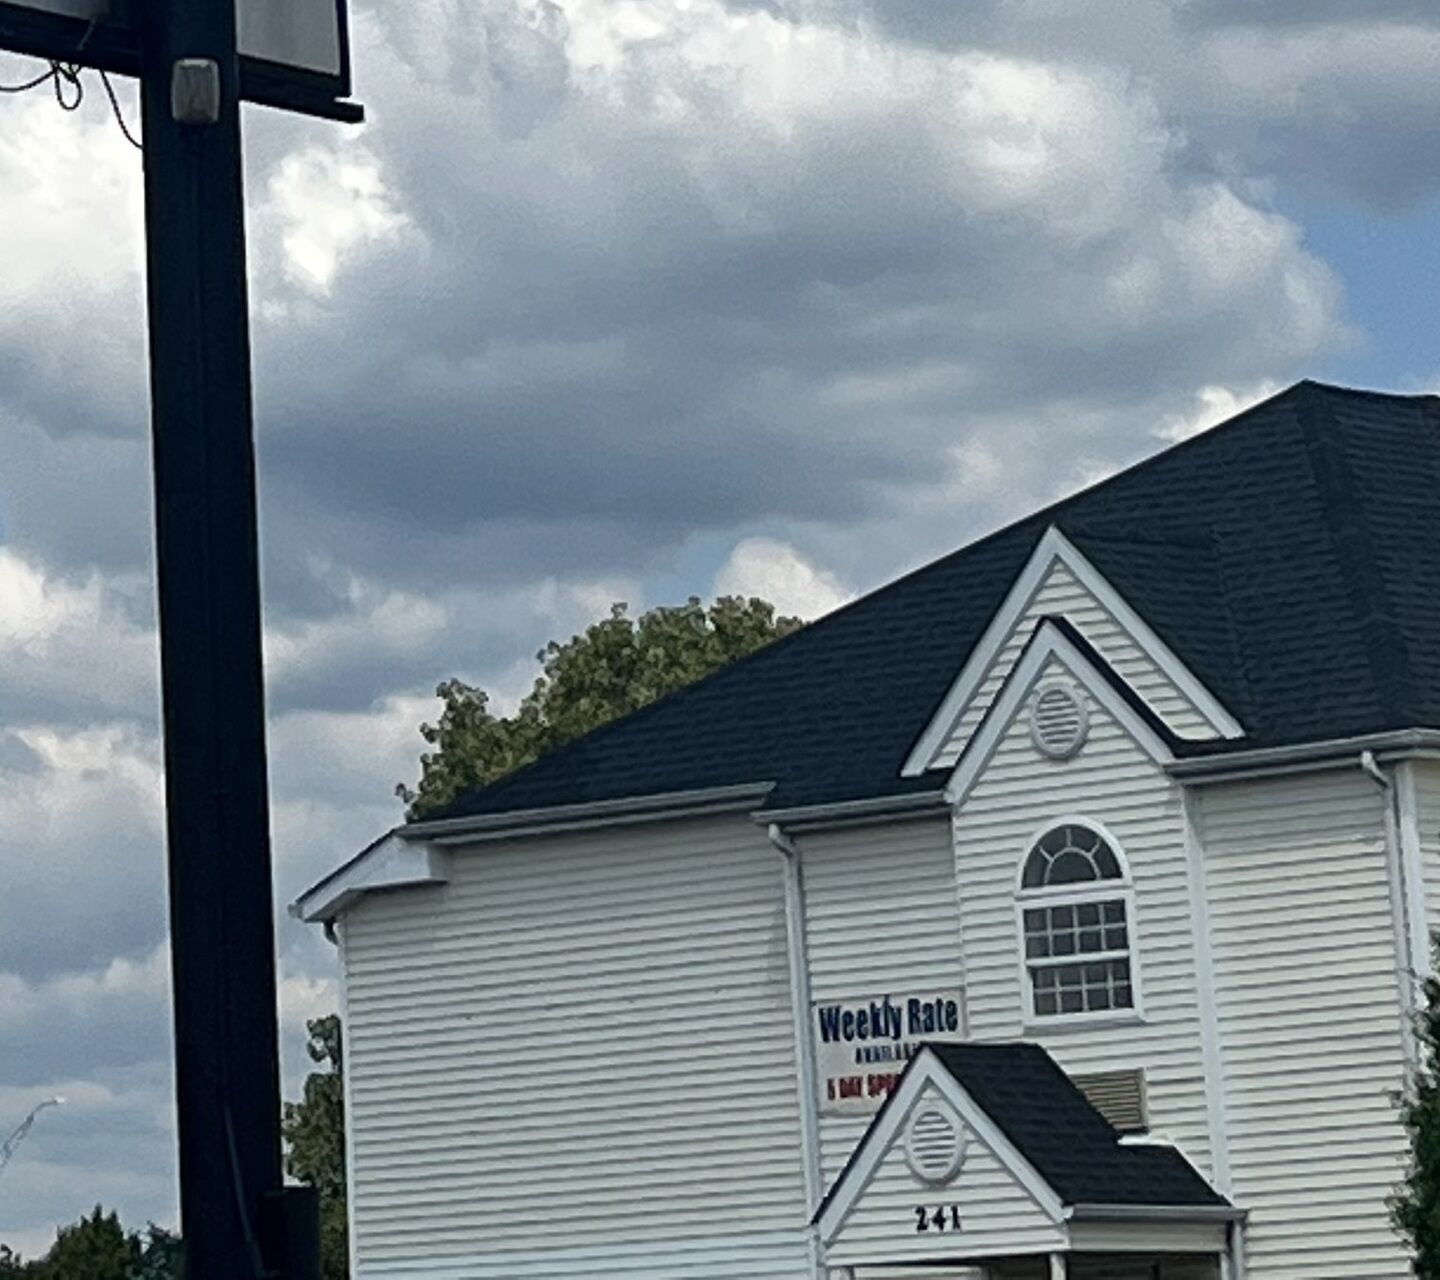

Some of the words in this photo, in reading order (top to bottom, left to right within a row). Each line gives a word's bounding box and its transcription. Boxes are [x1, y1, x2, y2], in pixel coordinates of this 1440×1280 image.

[818, 995, 902, 1043] Weekly
[907, 998, 958, 1035] Rate
[914, 1205, 961, 1231] 241
